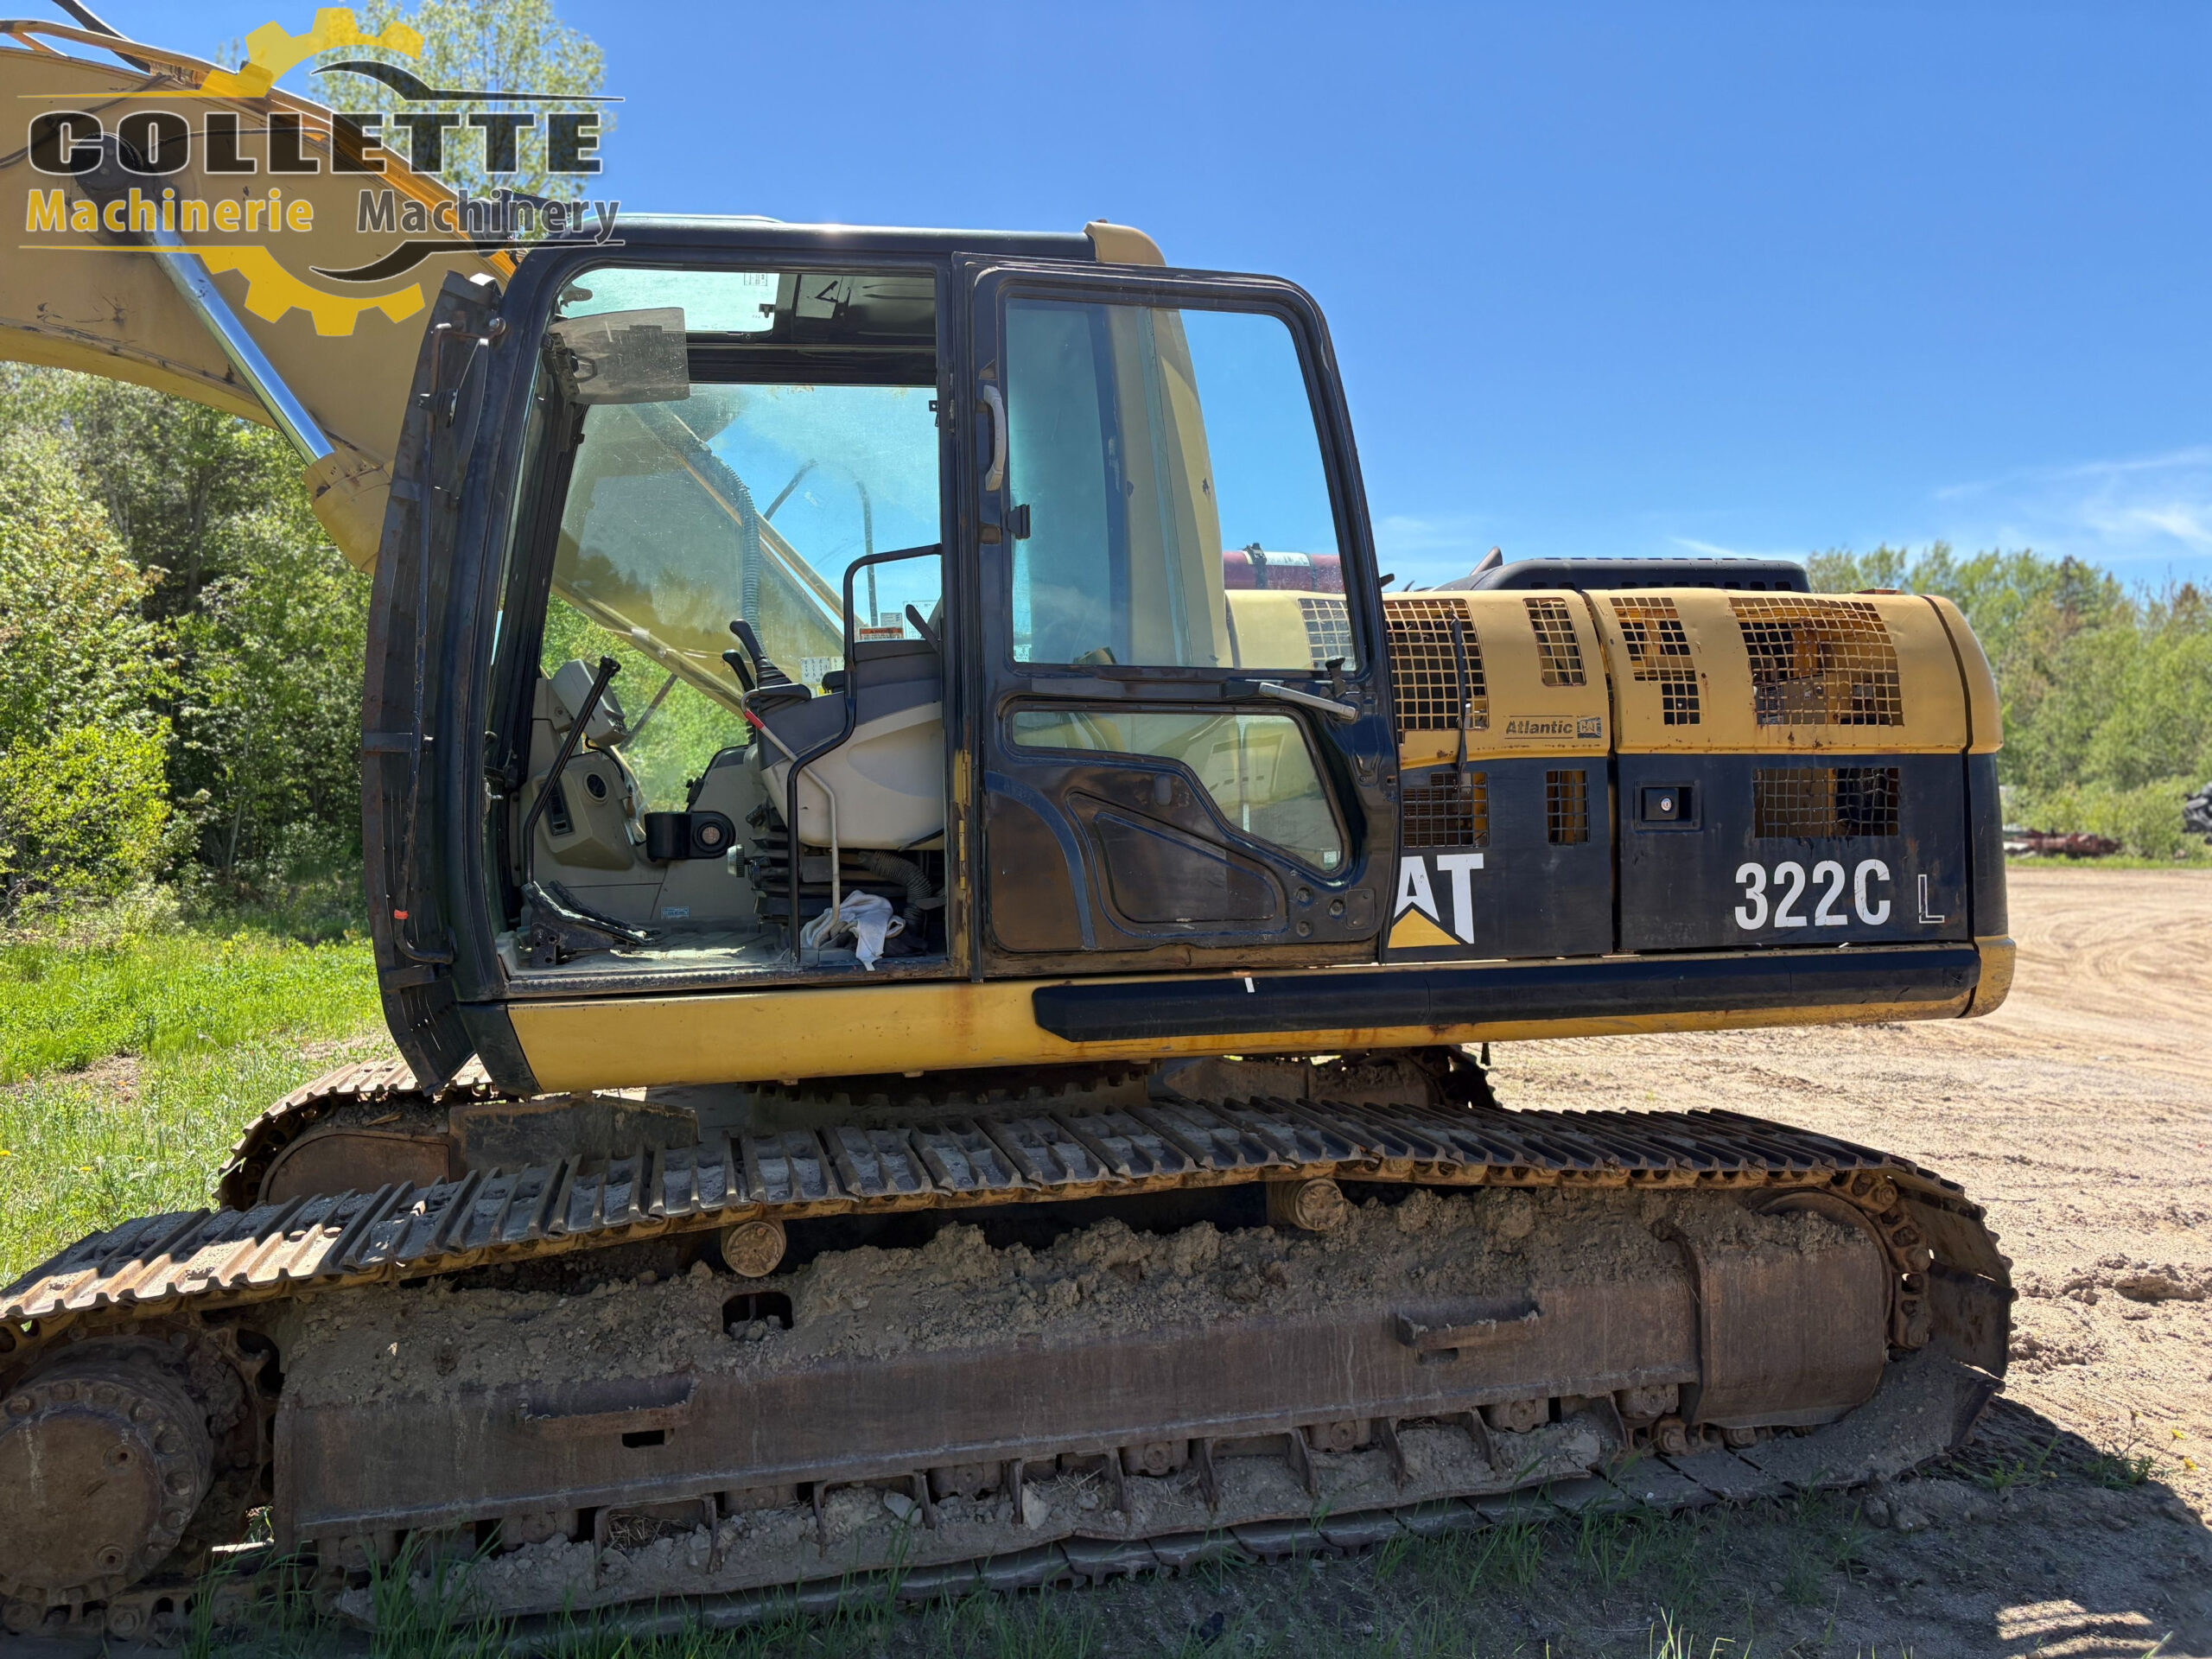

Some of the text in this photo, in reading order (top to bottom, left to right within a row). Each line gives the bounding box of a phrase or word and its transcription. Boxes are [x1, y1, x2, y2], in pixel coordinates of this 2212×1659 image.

[1506, 720, 1573, 734] Atlantic
[1394, 853, 1484, 944] AT
[1734, 859, 1945, 931] 322C L
